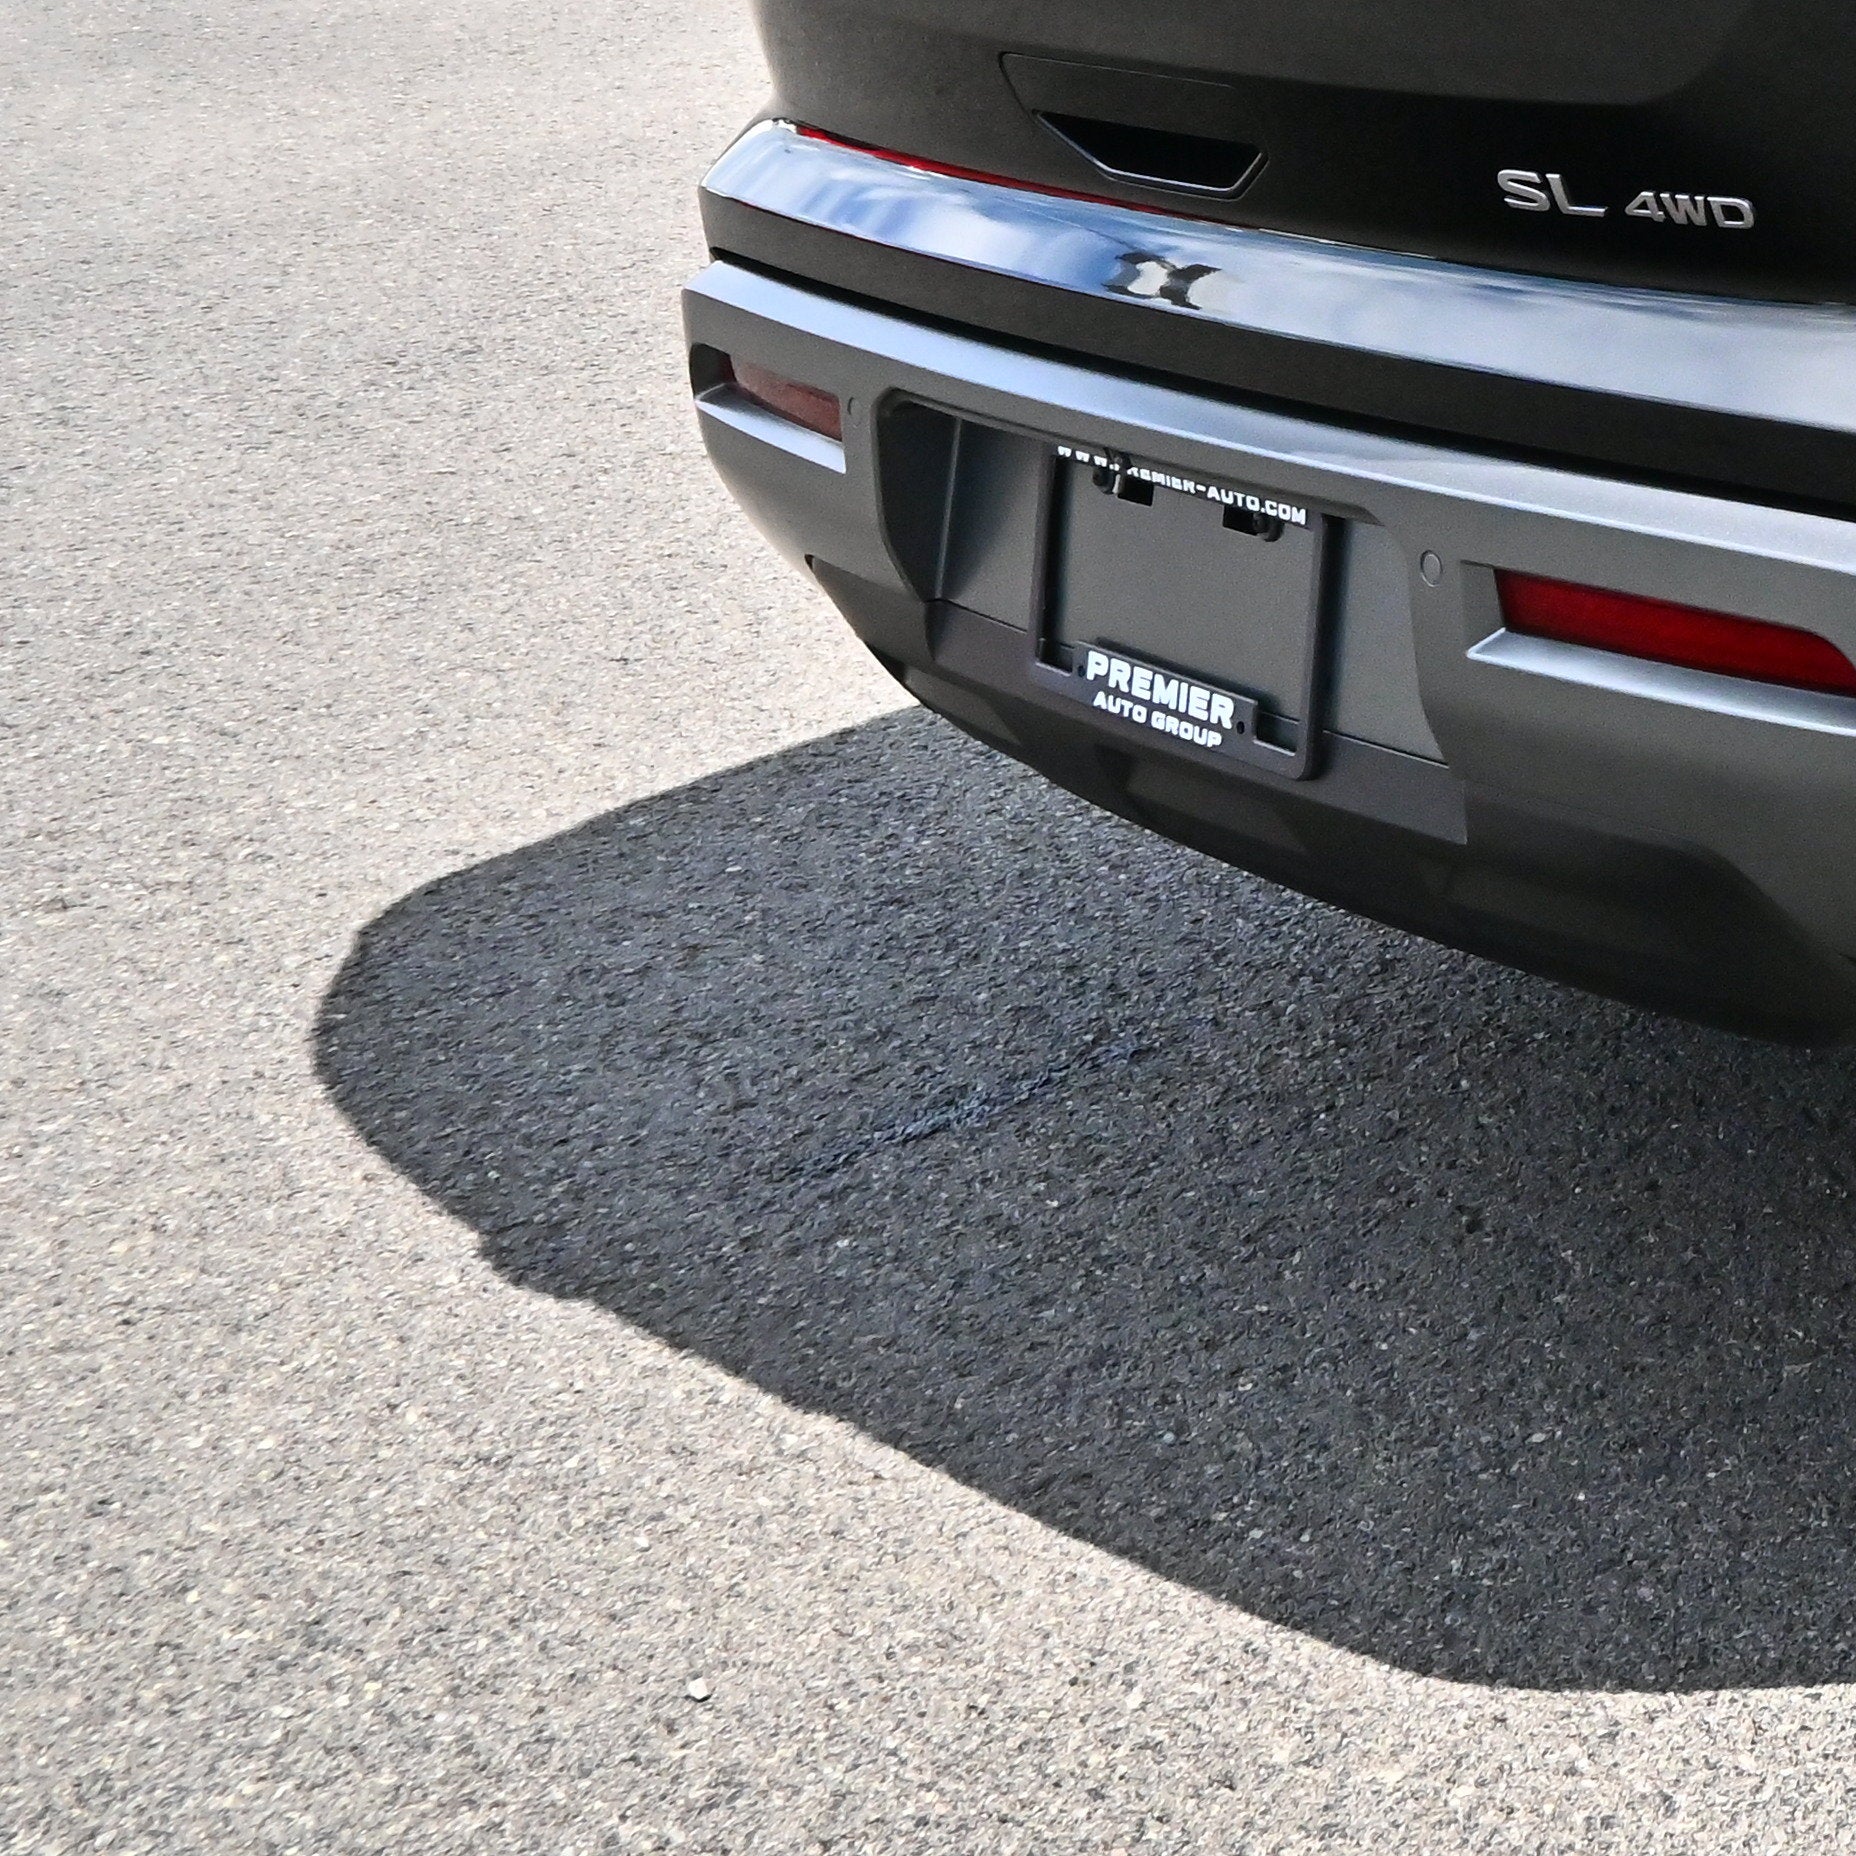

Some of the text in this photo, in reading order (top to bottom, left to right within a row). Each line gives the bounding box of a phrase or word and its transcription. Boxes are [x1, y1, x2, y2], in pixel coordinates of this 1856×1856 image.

[1497, 168, 1755, 229] SL 4WD
[1086, 650, 1235, 730] PREMIER
[1093, 691, 1223, 748] AUTO GROUP
